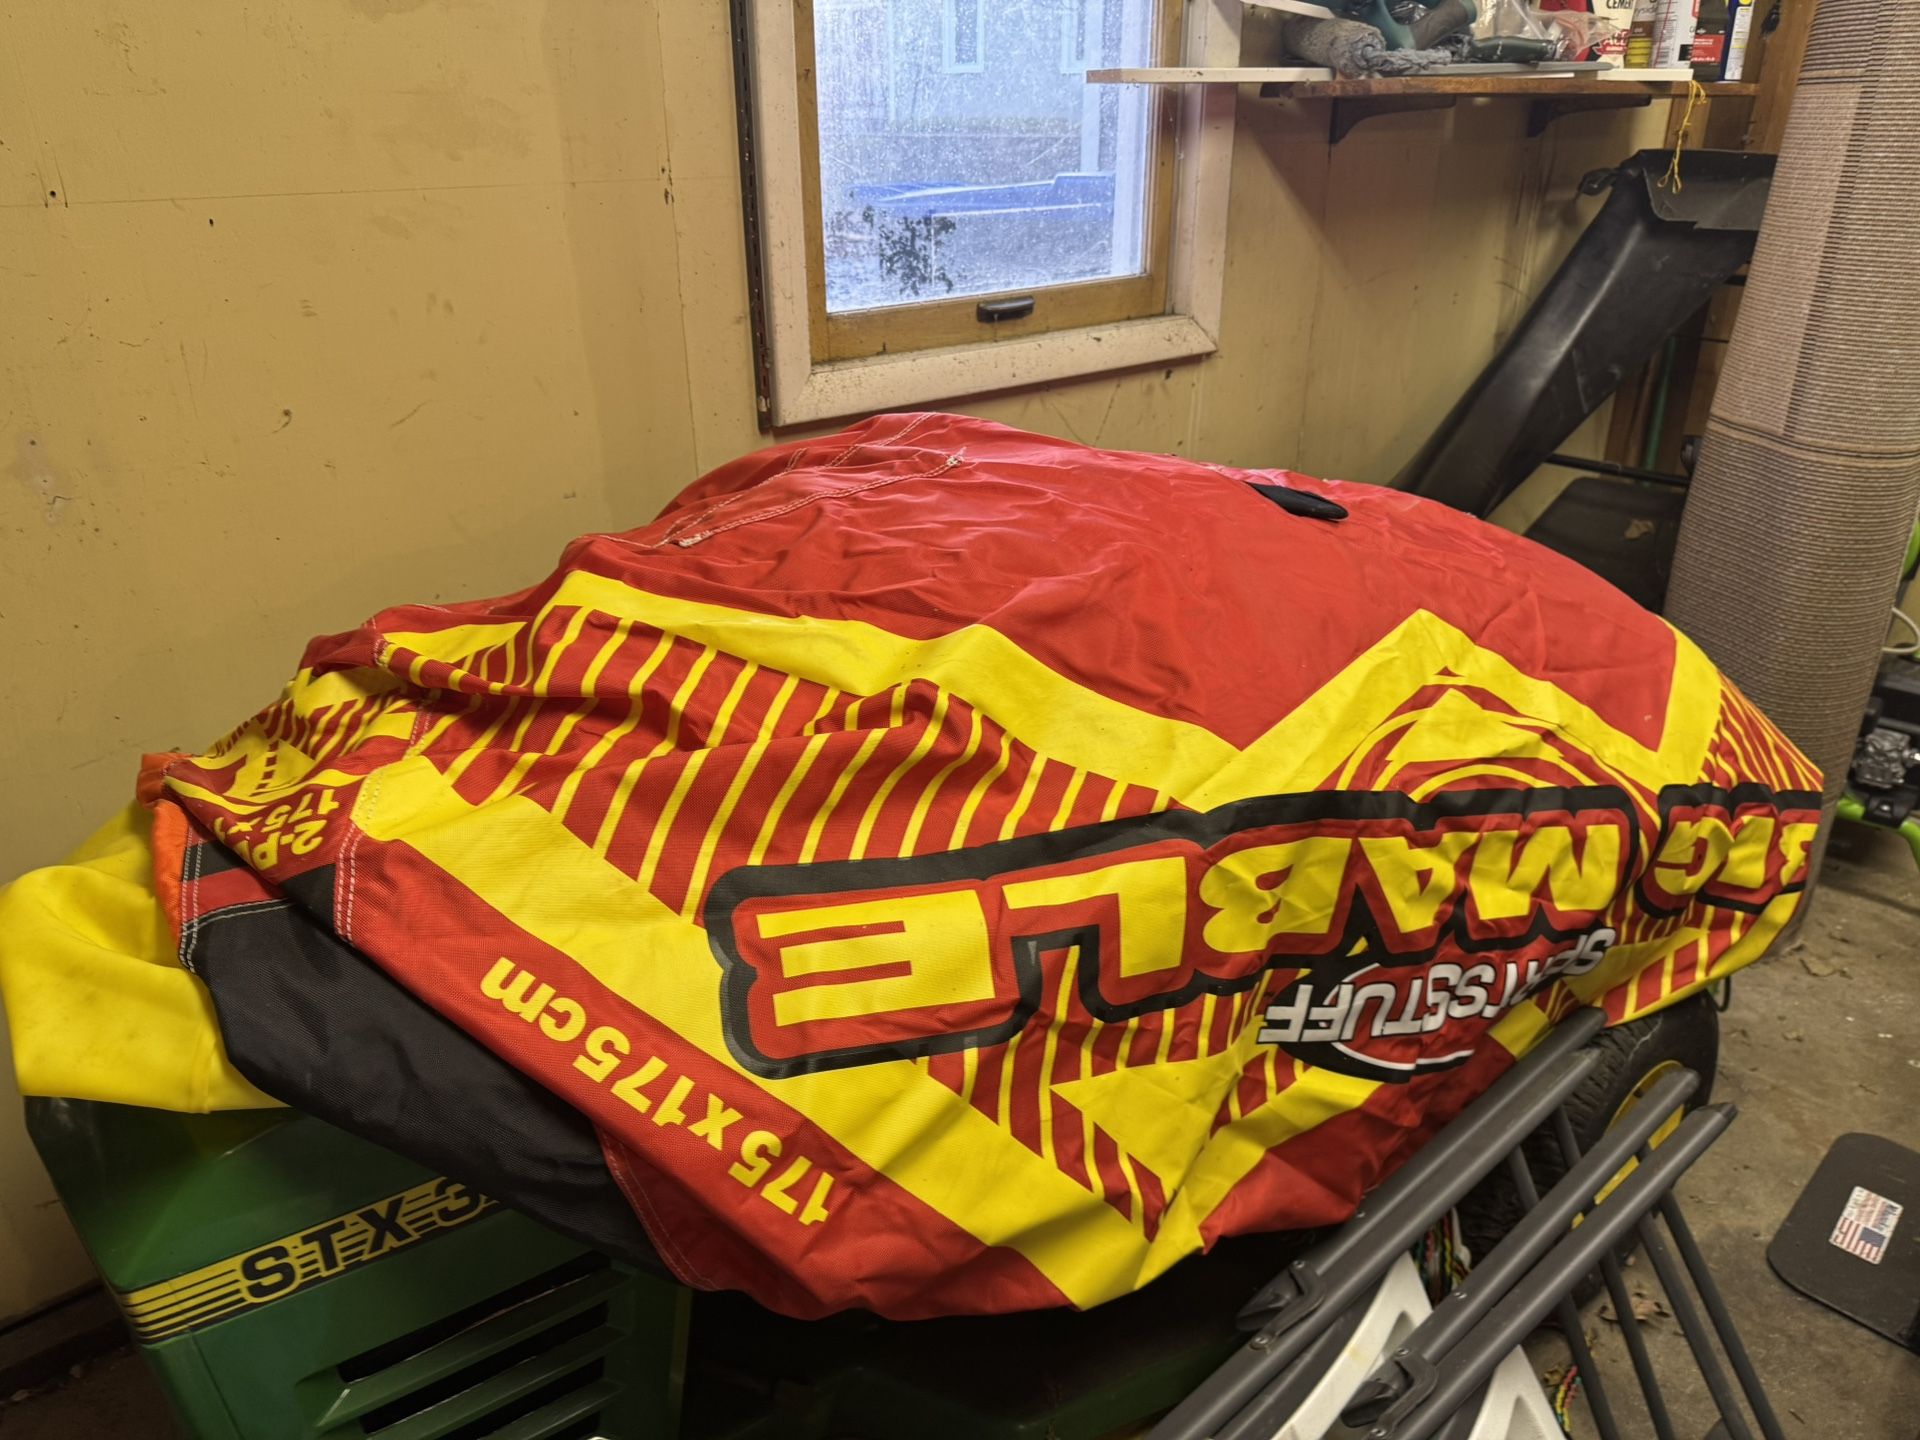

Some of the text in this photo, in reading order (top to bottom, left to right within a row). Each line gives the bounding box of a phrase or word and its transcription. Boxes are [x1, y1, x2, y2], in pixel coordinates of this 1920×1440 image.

[260, 788, 341, 833] 175
[755, 822, 1627, 1028] MABLE
[1256, 926, 1617, 1045] SPRTSSTUFF
[727, 1130, 836, 1226] 175
